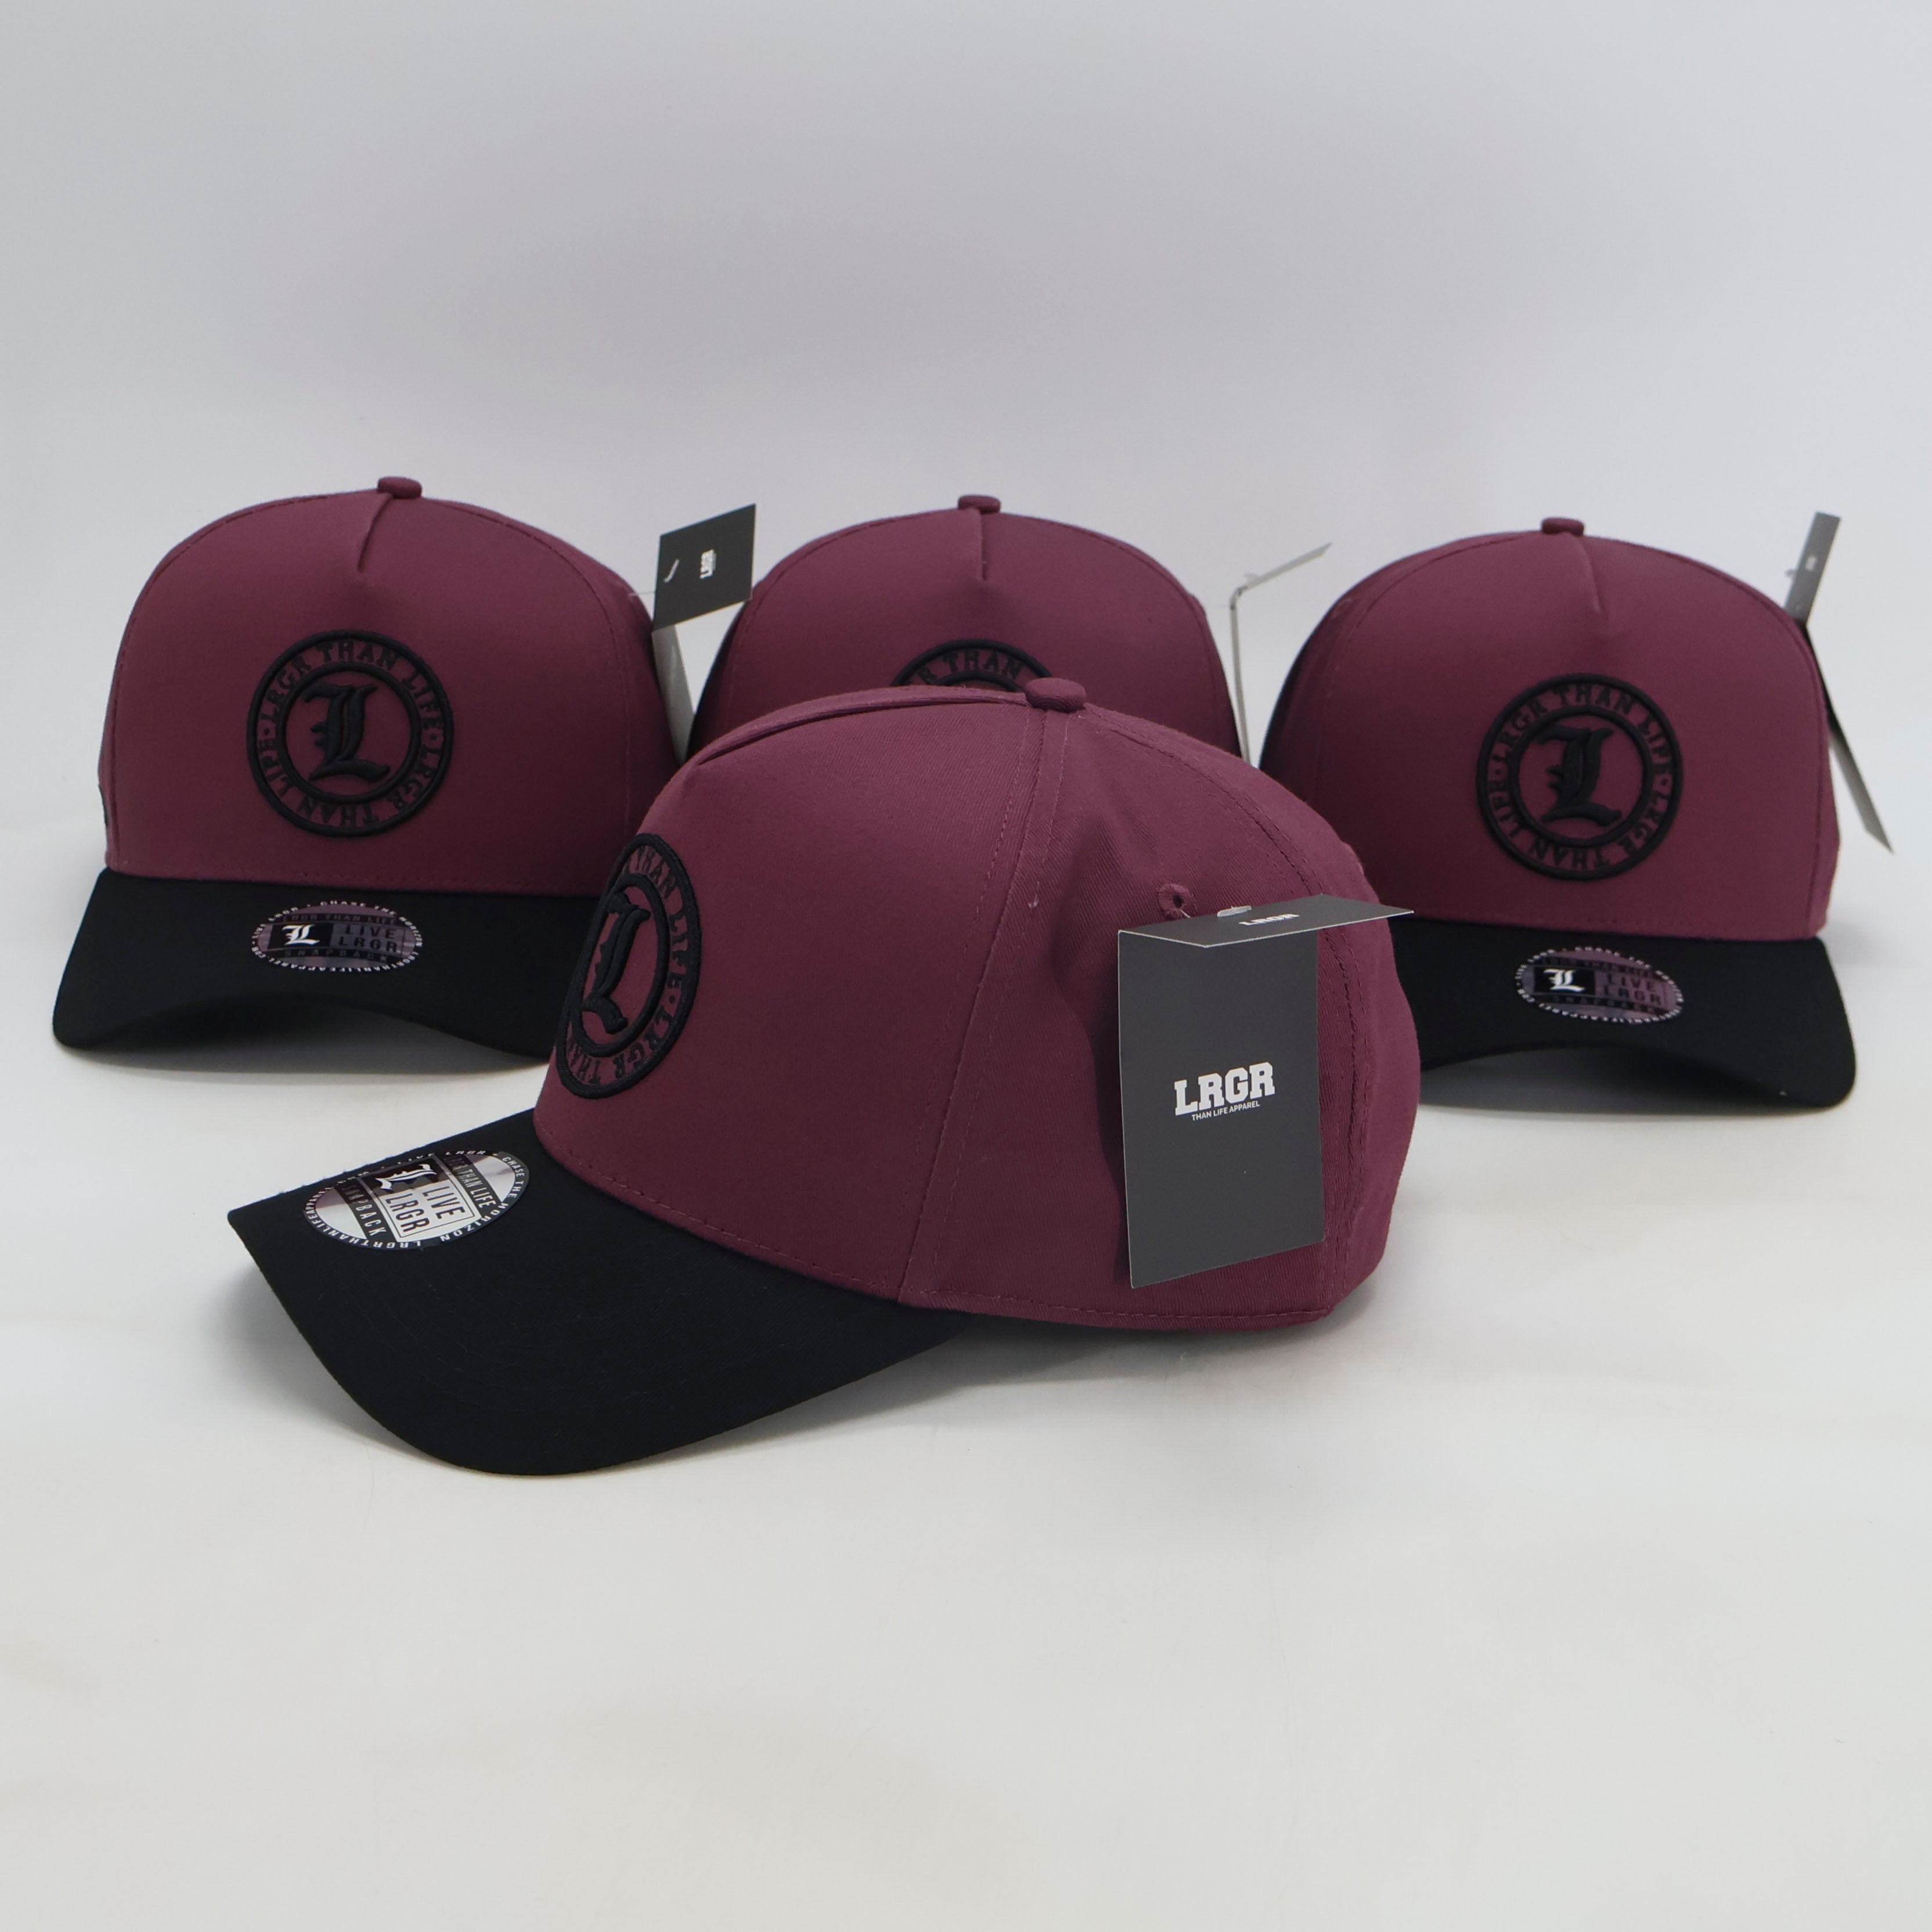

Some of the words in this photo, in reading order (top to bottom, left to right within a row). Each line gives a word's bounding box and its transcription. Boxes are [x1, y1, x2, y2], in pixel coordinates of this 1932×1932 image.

[259, 655, 311, 725] LRGR
[316, 640, 401, 670] THAN
[402, 668, 442, 730] LIFE
[296, 796, 381, 827] THAN
[344, 925, 397, 939] LIVE
[1173, 1062, 1275, 1116] LRGR
[1191, 1111, 1212, 1121] THAN
[1213, 1106, 1228, 1117] LIFE
[1229, 1101, 1260, 1114] APPAREL
[502, 1156, 525, 1178] CHASE
[422, 1185, 466, 1220] LIVE
[470, 1187, 497, 1208] LIFE
[508, 1180, 525, 1199] THE
[341, 1185, 387, 1236] APBACK
[385, 1193, 430, 1232] LRGR
[440, 1202, 510, 1242] HORIZON
